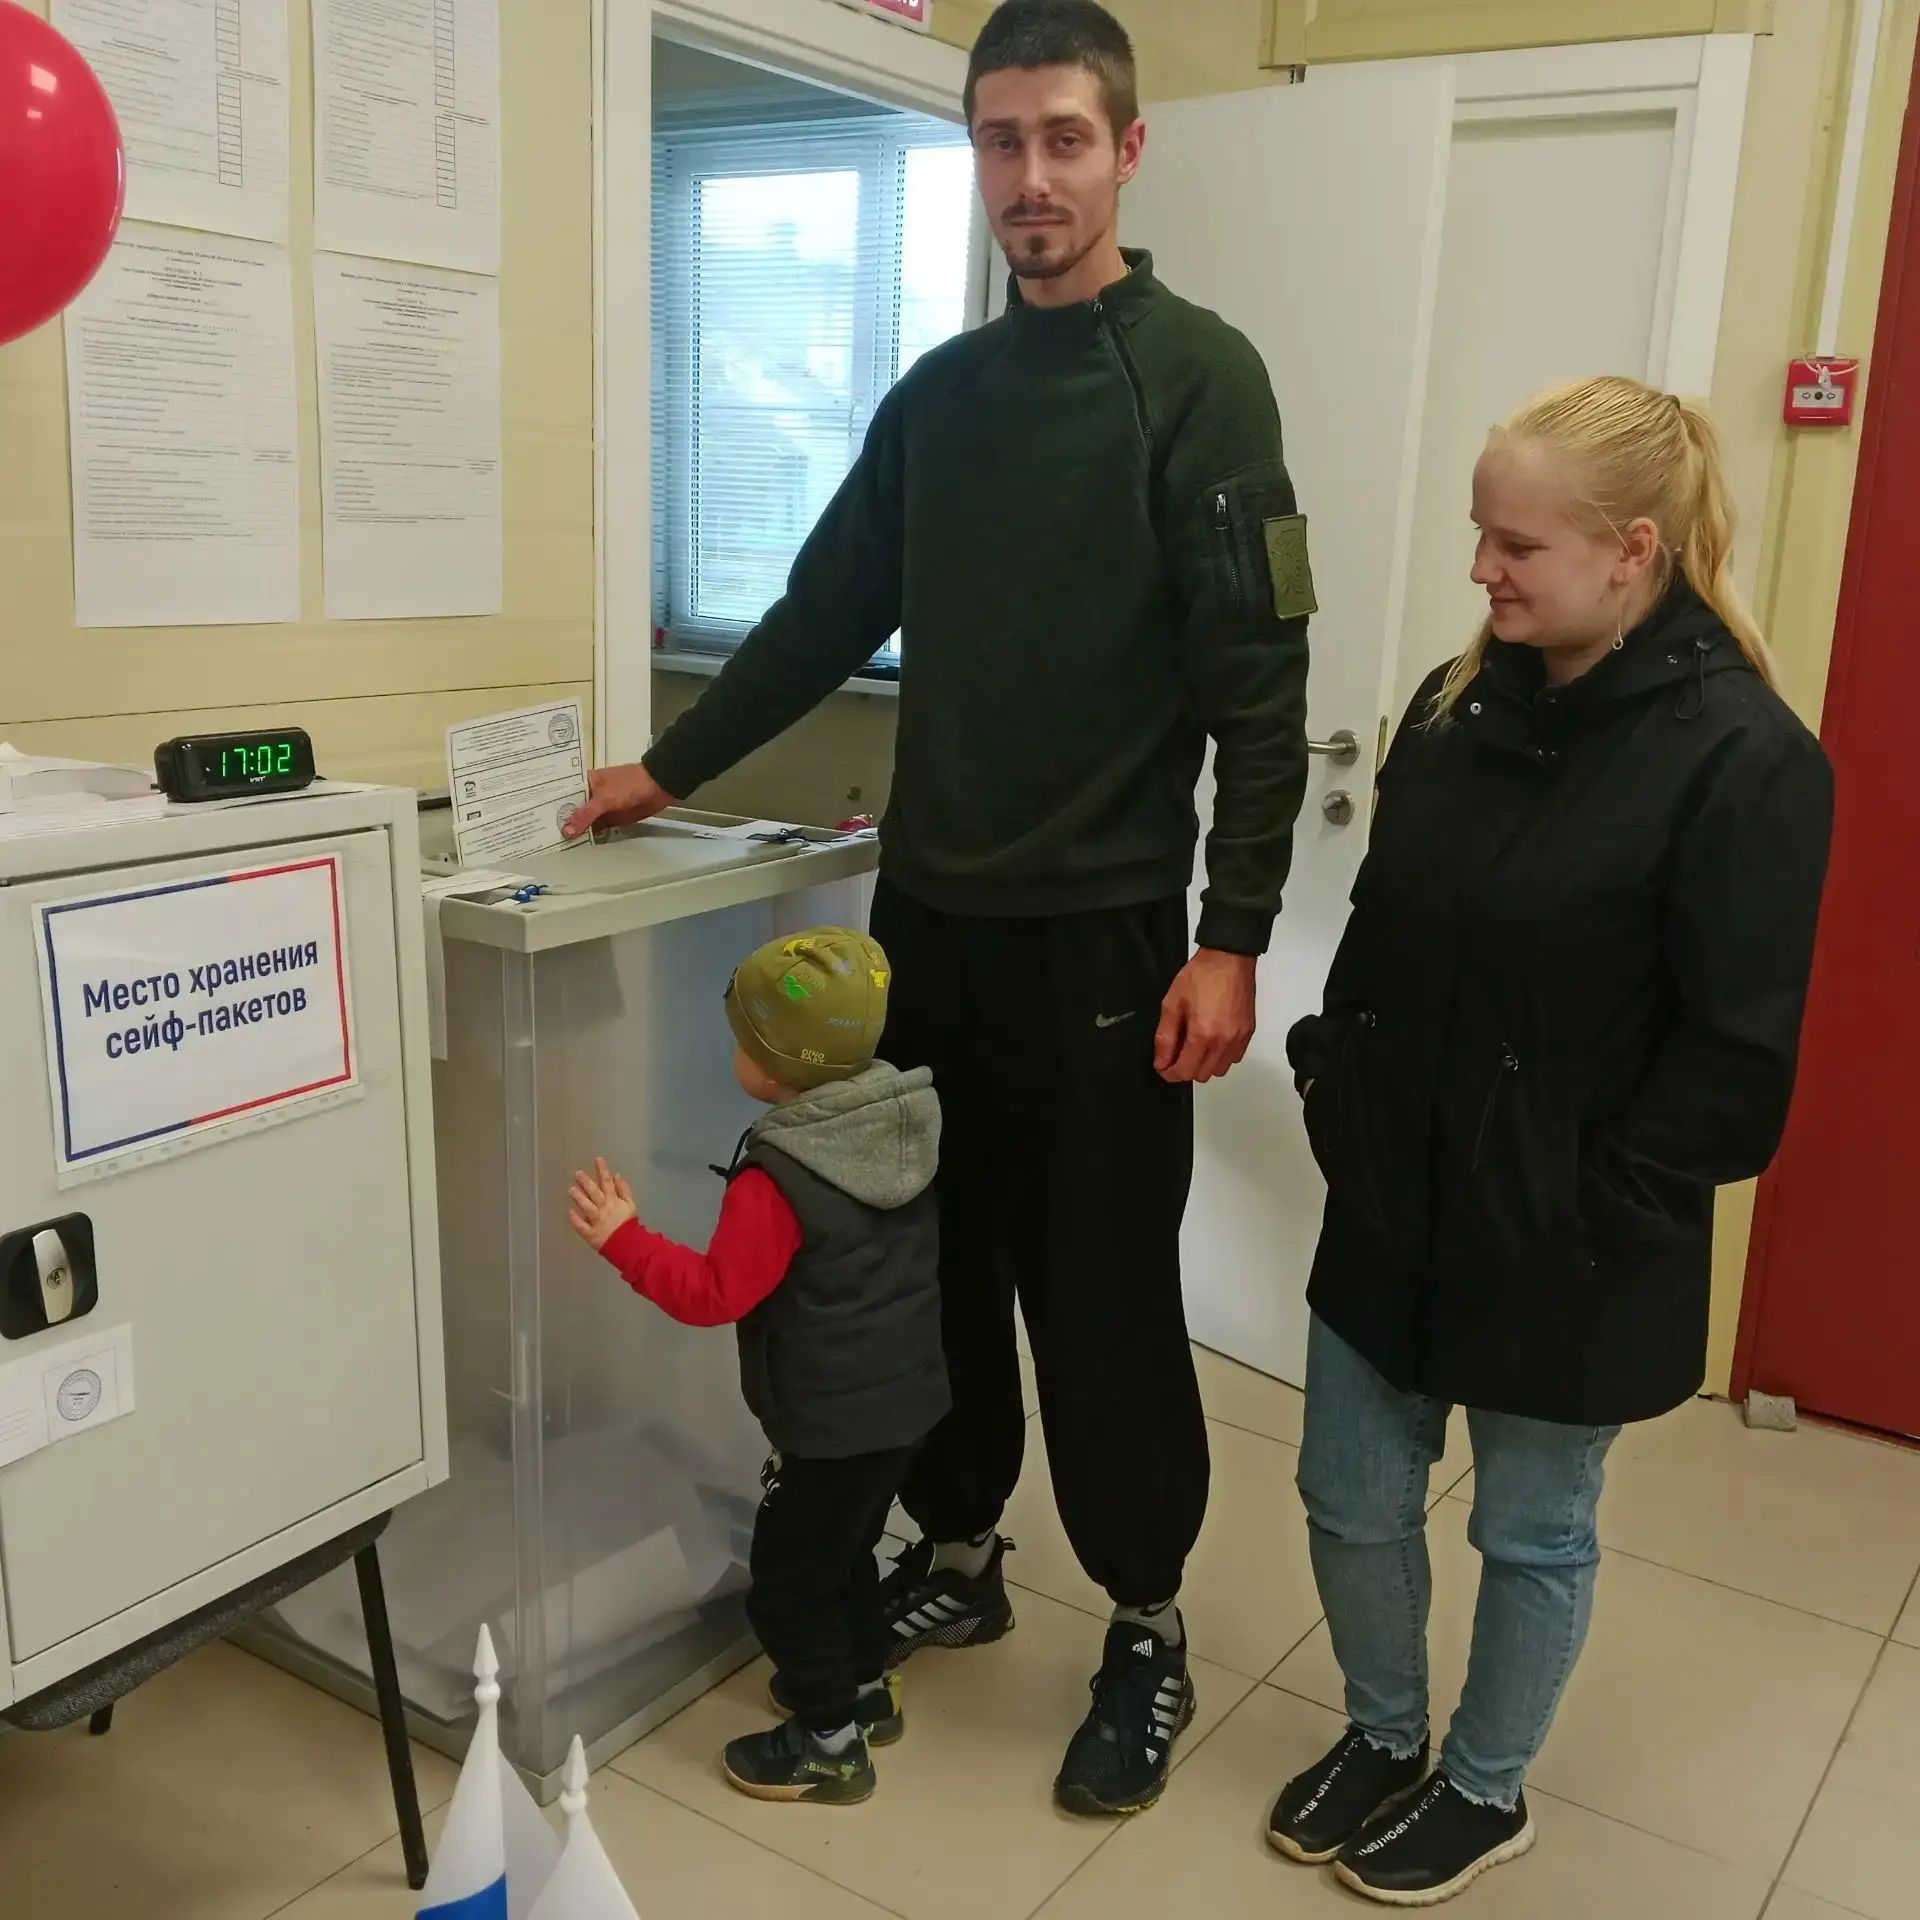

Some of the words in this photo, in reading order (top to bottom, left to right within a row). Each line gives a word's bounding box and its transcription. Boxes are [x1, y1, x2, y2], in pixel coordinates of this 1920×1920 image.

[222, 744, 290, 776] 17:02
[83, 972, 180, 1017] Место
[188, 941, 319, 997] хранения
[106, 987, 307, 1059] сейф-пакетов
[801, 1048, 825, 1060] DINO
